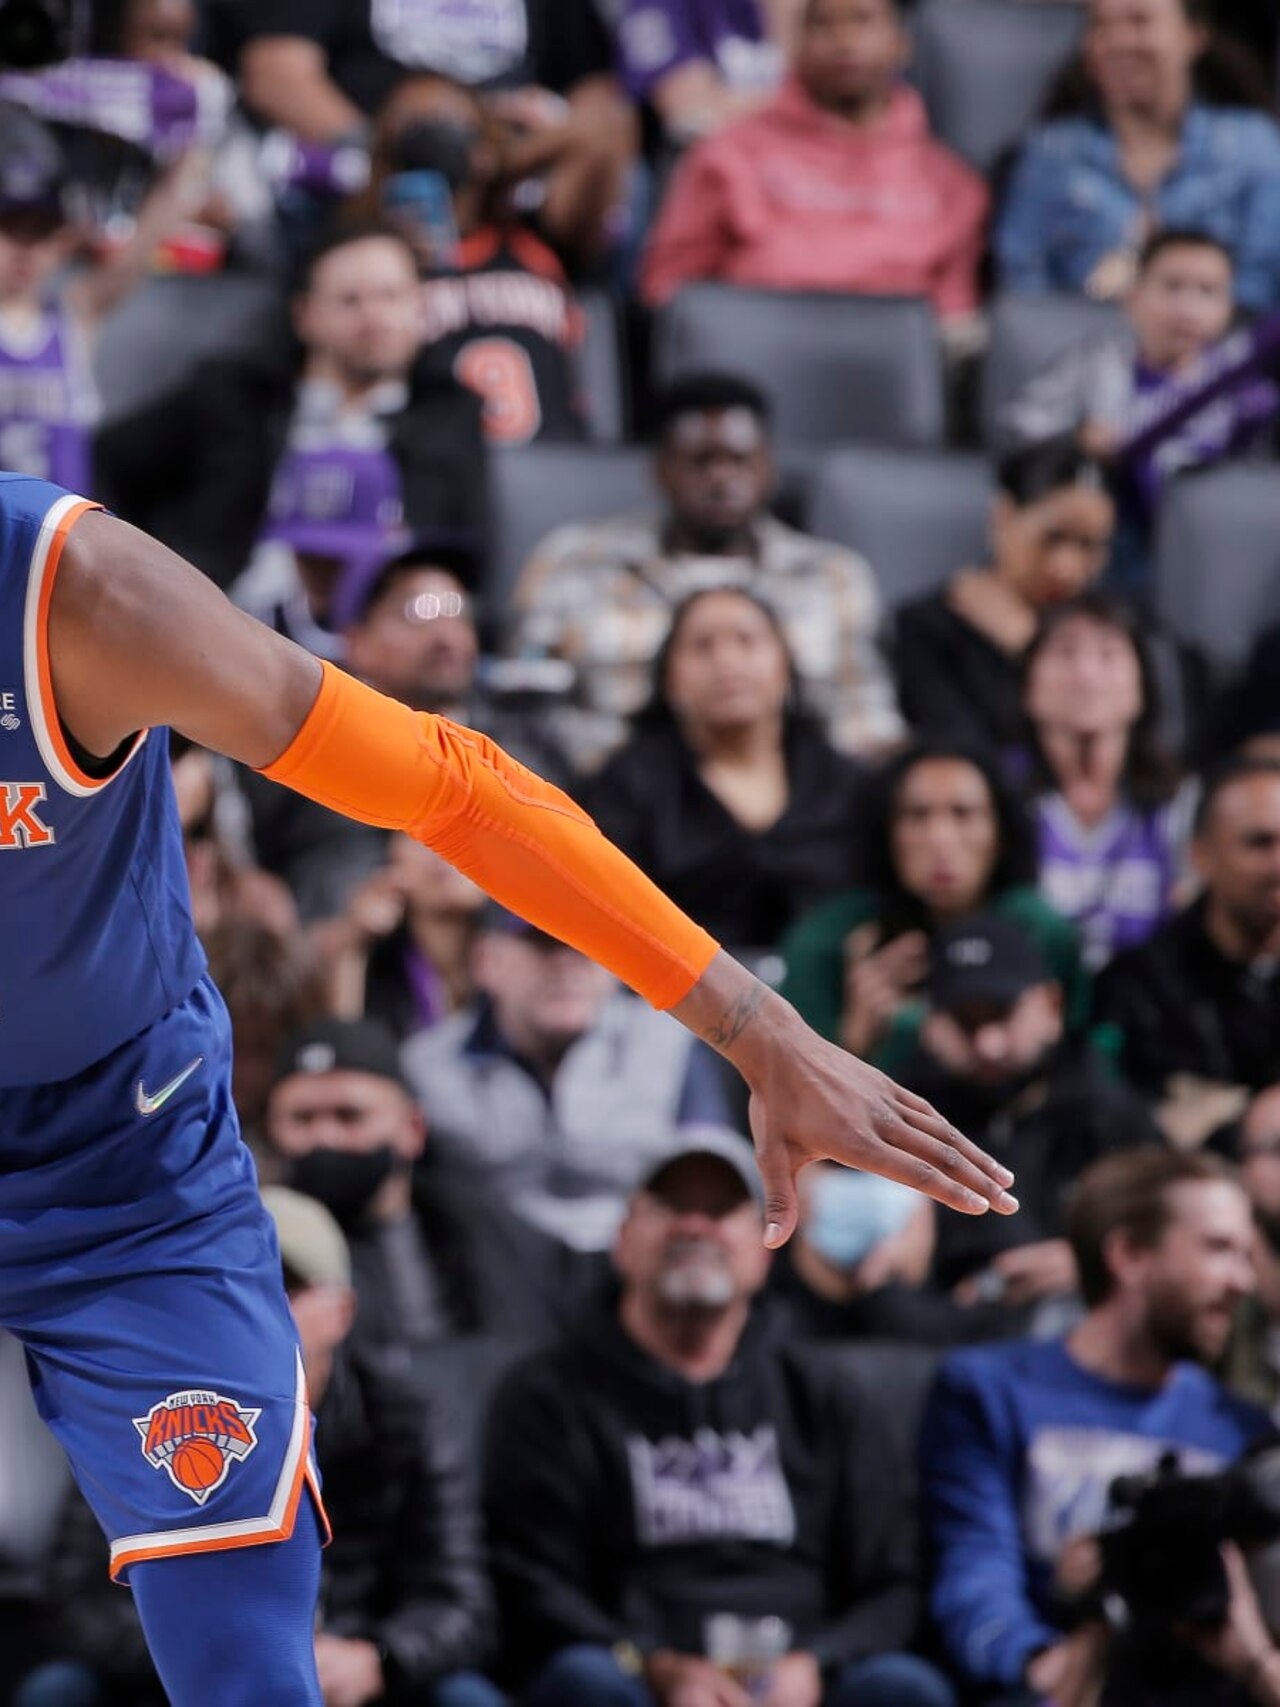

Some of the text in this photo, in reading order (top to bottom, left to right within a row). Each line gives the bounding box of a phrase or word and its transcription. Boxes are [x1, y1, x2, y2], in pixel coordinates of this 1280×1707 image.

[168, 1393, 217, 1408] NEW YORK
[145, 1401, 254, 1456] KNICKS
